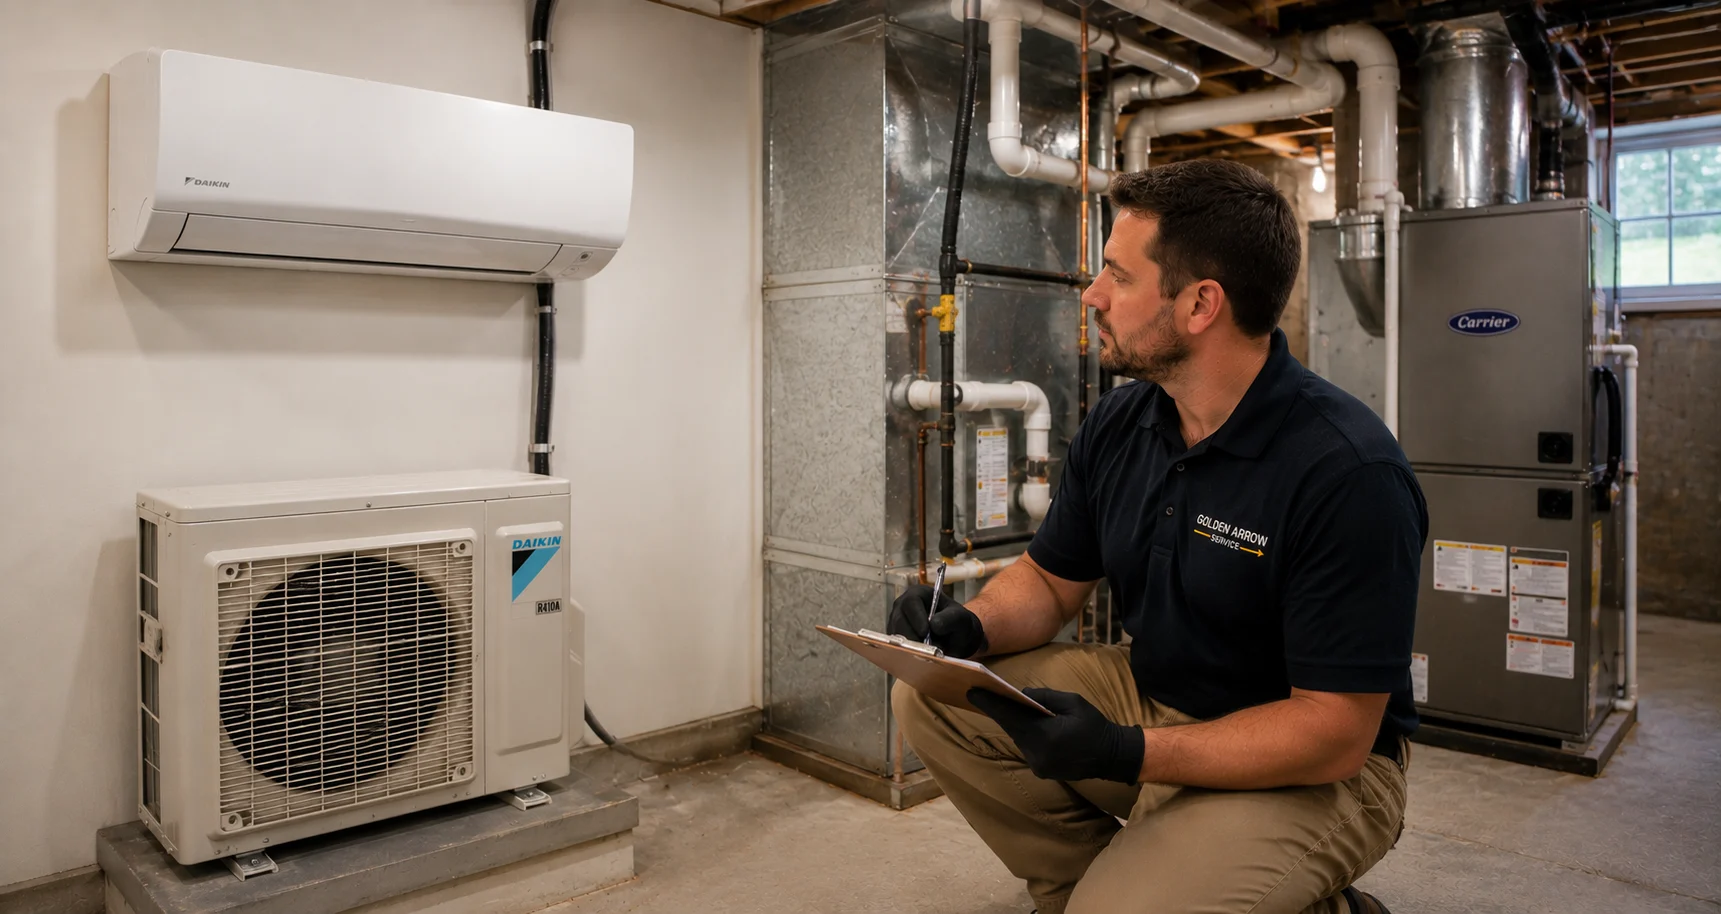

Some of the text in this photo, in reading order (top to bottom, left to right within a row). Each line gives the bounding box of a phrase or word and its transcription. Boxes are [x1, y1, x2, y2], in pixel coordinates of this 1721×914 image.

[194, 179, 230, 188] DAIKIN
[1458, 316, 1510, 329] Carrier
[1197, 514, 1268, 547] GOLDEN ARROW
[512, 536, 562, 549] DAIKIN
[537, 601, 560, 613] R410A
